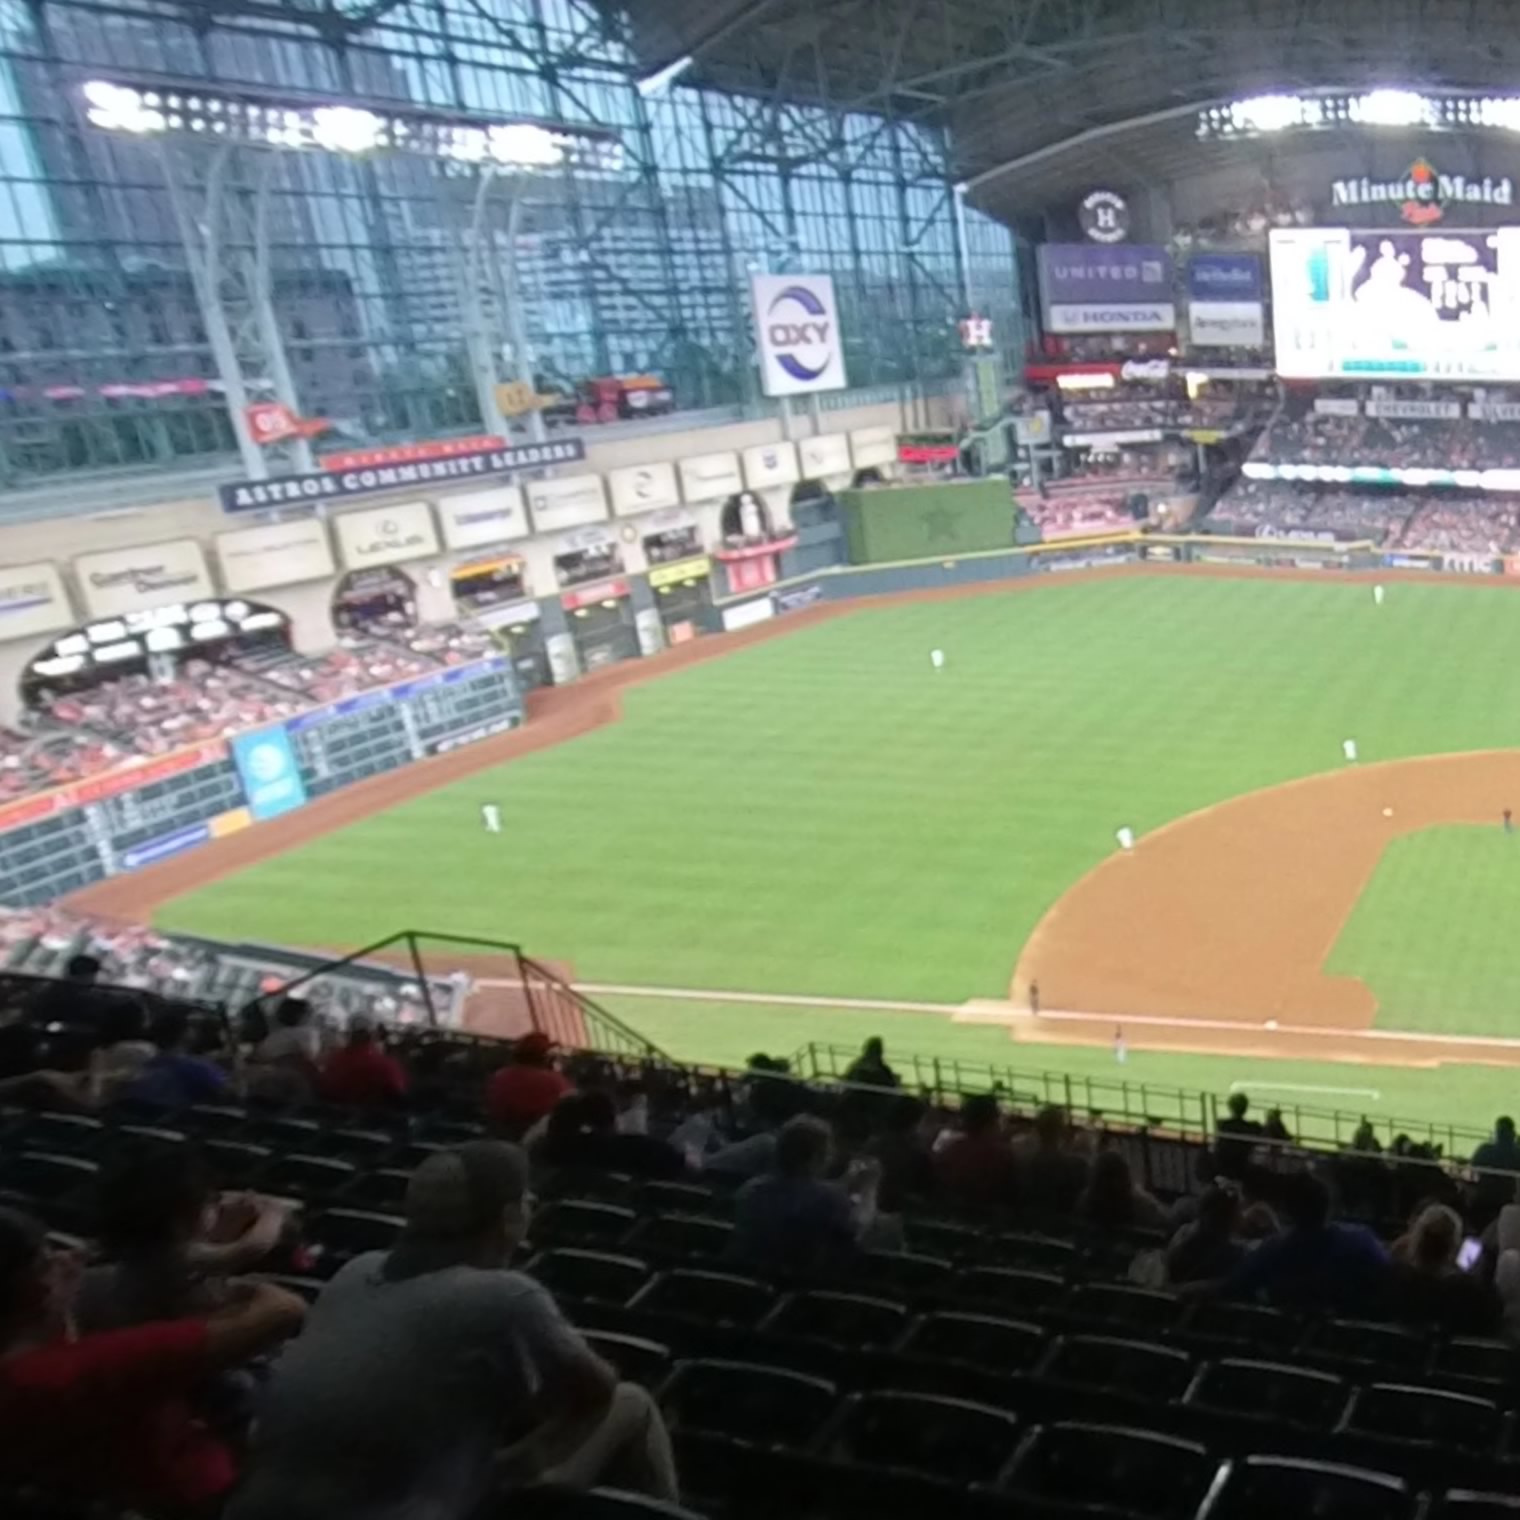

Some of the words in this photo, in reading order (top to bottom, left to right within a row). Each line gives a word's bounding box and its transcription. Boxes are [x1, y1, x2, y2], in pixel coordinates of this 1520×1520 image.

[1331, 176, 1434, 206] Minute
[1437, 174, 1513, 205] Maid
[1096, 207, 1116, 228] H
[1054, 264, 1138, 280] UNITED
[1083, 311, 1163, 323] HONDA
[768, 321, 830, 348] OXY
[1375, 403, 1452, 417] CHEVROLET
[236, 473, 337, 507] ASTROS
[342, 456, 485, 489] COMMUNITY
[490, 442, 578, 468] LEADERS
[355, 534, 425, 555] LEXUS
